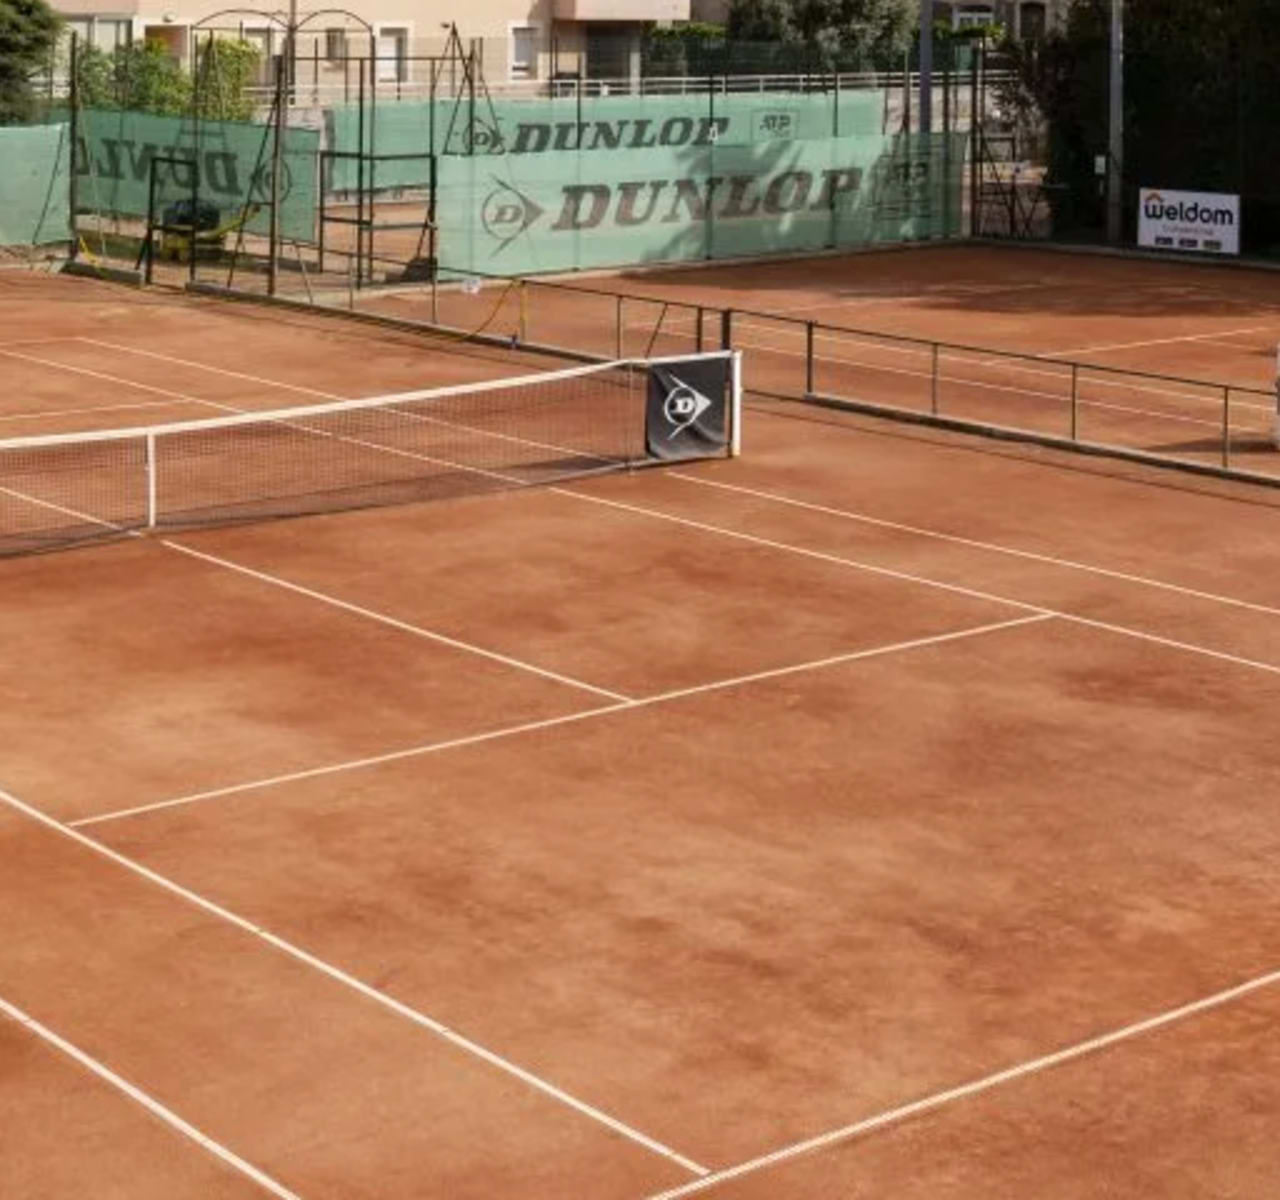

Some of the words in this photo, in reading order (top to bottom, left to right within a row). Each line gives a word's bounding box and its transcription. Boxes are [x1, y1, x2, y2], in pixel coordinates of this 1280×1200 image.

[510, 117, 730, 154] DUNLOP
[550, 168, 862, 231] DUNLOP
[1144, 201, 1233, 225] weldom
[669, 398, 694, 414] D
